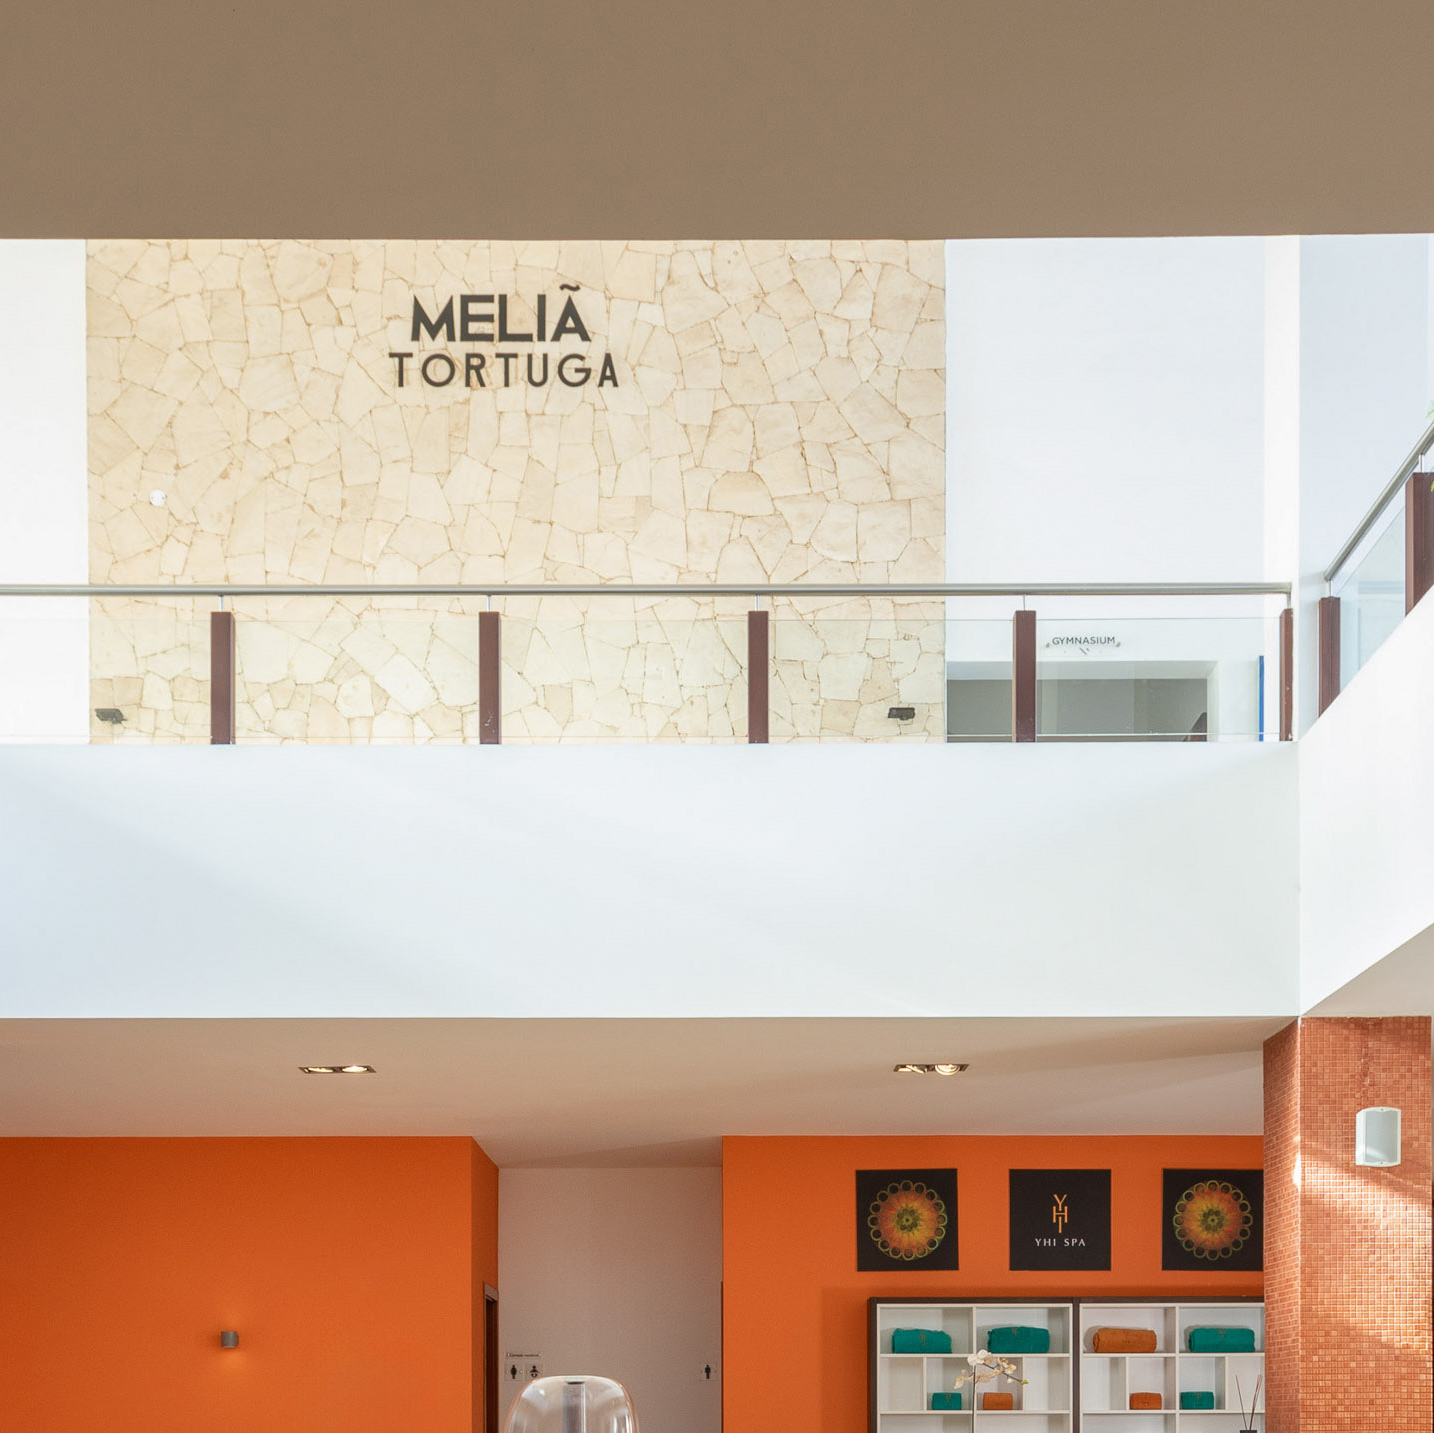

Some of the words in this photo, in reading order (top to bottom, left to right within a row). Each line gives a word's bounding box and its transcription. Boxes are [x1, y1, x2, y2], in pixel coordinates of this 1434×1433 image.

[388, 352, 619, 388] TORTUGA
[1052, 636, 1116, 646] GYMNASIUM
[1035, 1238, 1057, 1247] YHI
[1064, 1238, 1086, 1247] SPA
